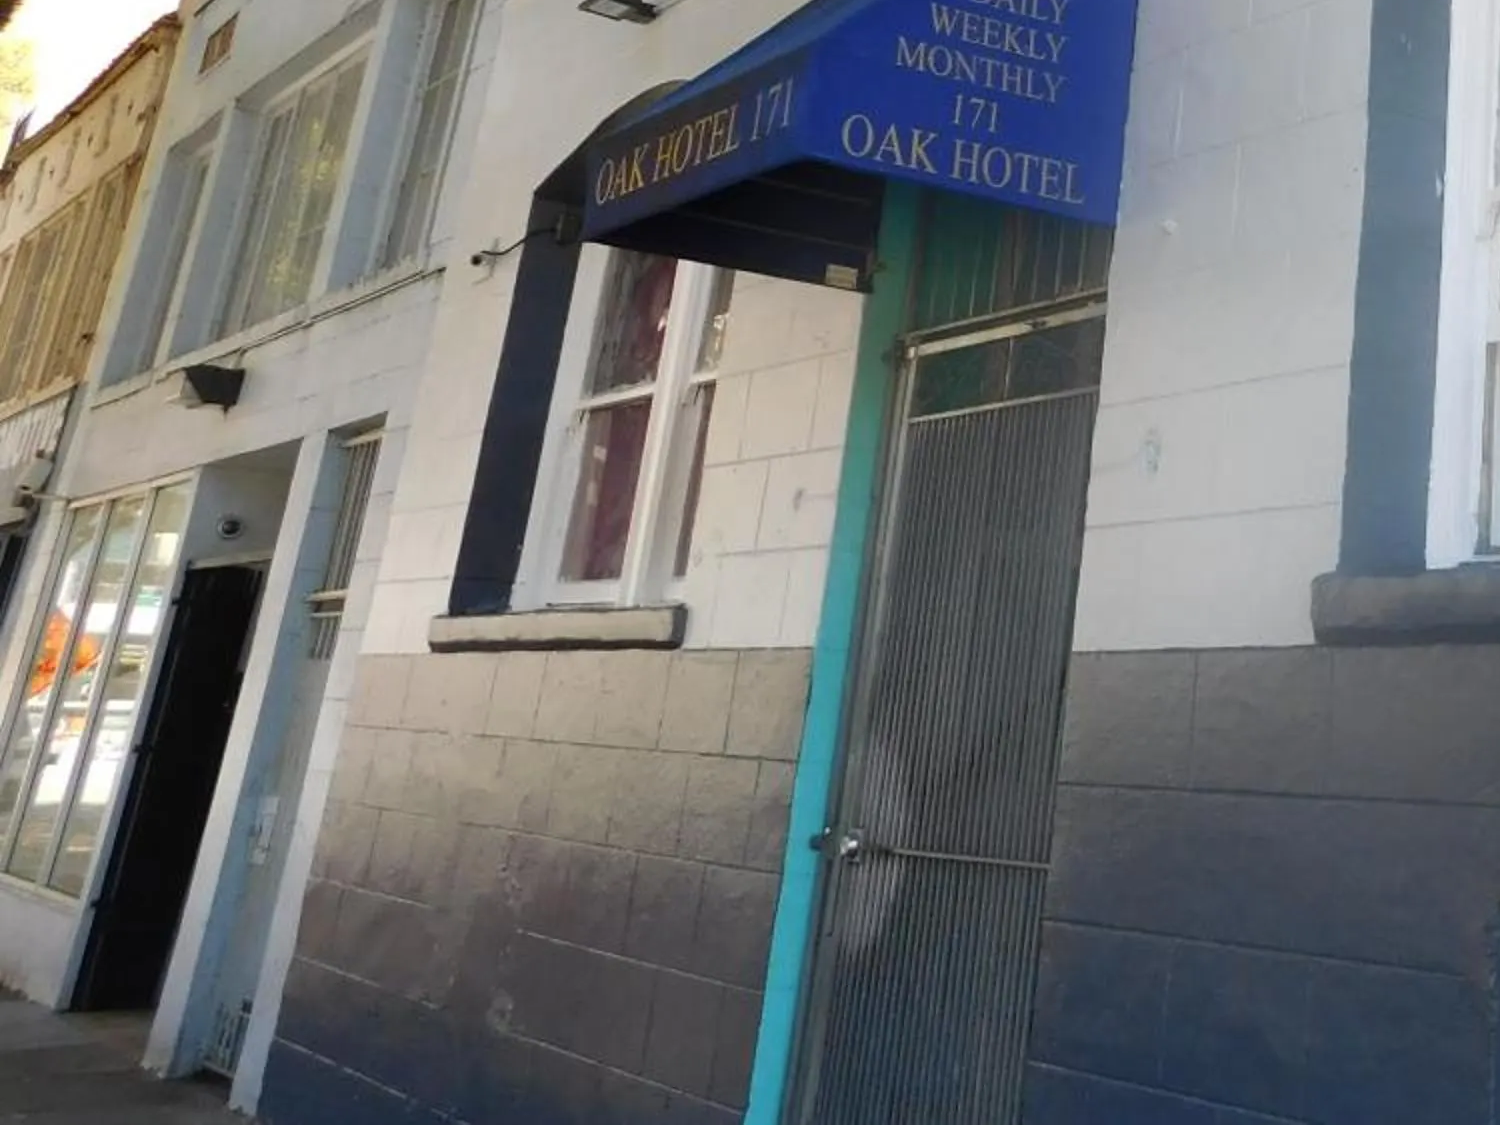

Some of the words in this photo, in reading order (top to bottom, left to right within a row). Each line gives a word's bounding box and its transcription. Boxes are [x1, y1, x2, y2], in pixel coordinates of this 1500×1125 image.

[931, 2, 1068, 64] WEEKLY
[896, 36, 1068, 104] MONTHLY
[595, 142, 649, 206] OAK
[652, 103, 740, 182] HOTEL
[751, 76, 795, 141] 171
[953, 94, 998, 134] 171
[841, 114, 938, 175] OAK
[950, 139, 1086, 205] HOTEL
